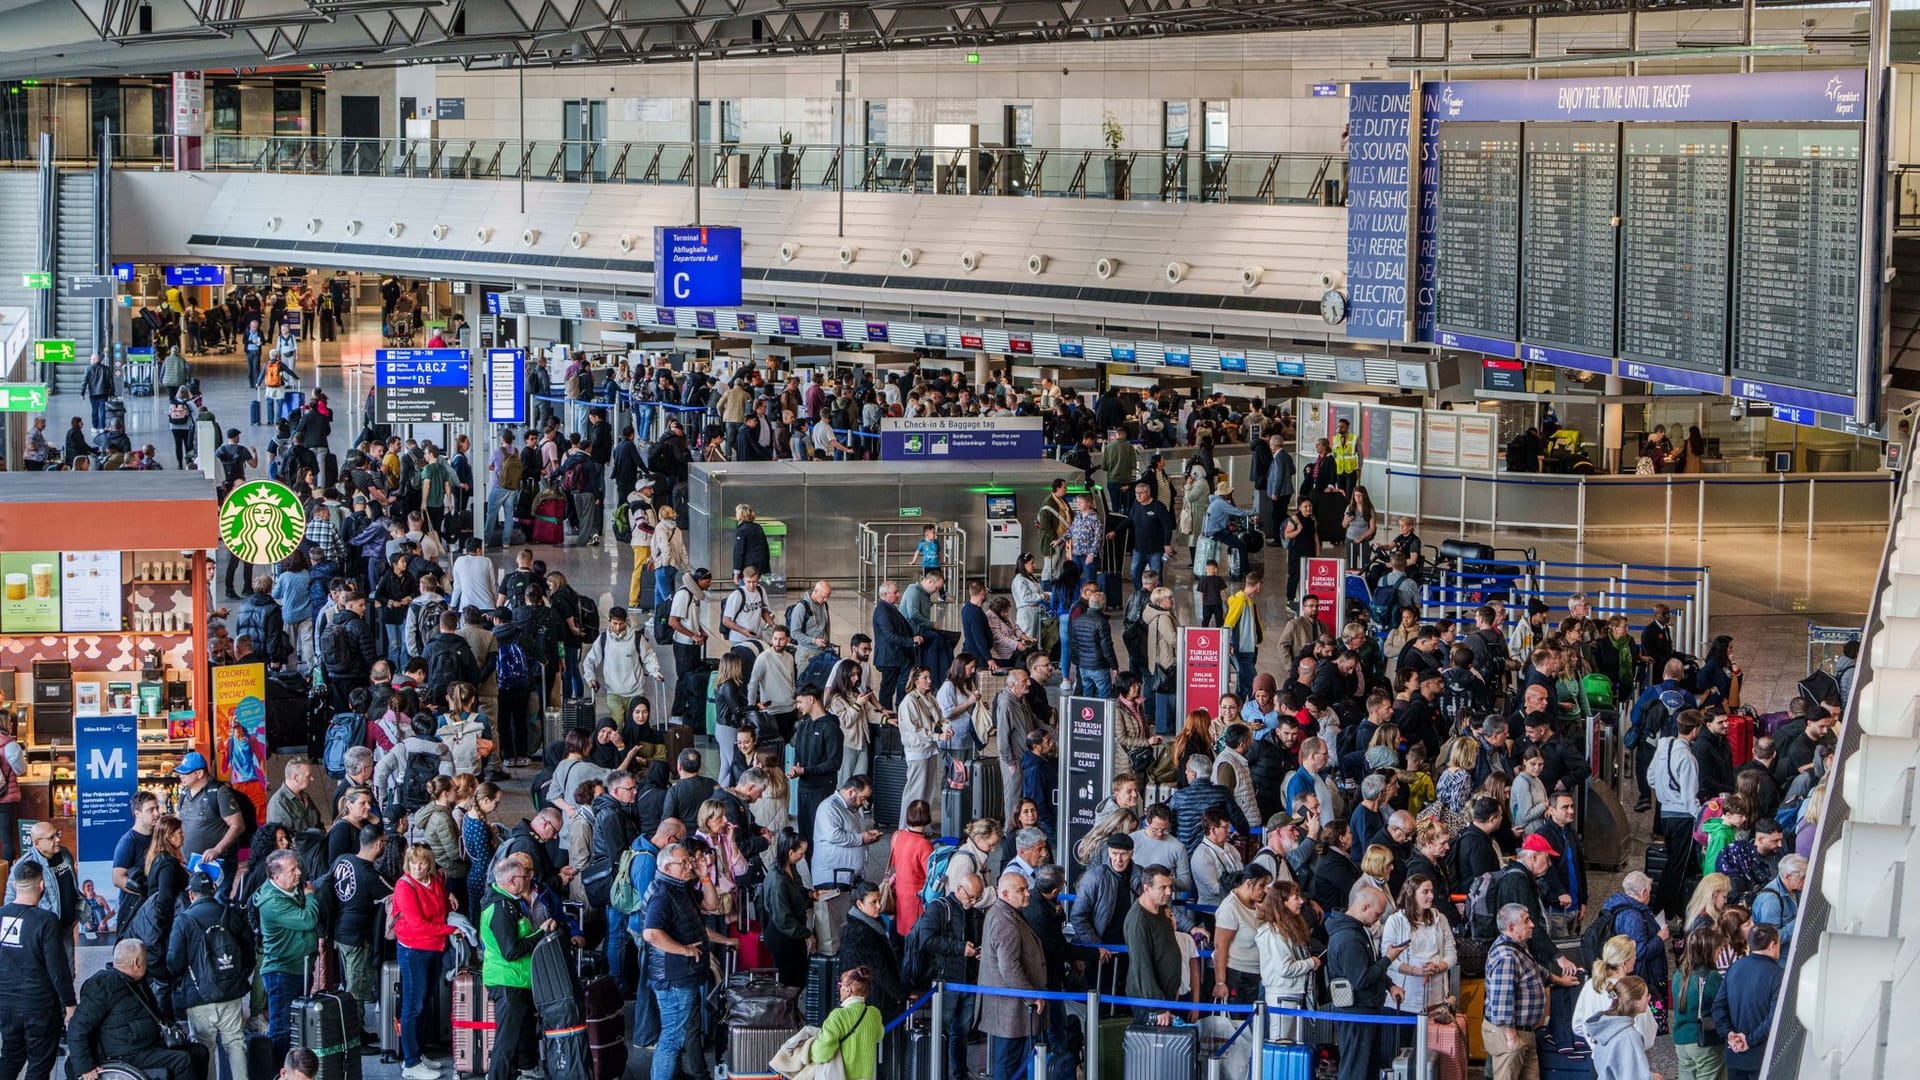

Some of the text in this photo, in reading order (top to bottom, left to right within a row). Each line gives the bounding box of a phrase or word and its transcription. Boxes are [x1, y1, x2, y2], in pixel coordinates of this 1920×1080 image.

[1558, 84, 1692, 114] ENJOY THE TIME UNTIL TAKEOFF
[1837, 91, 1860, 102] Frankfurt
[1350, 95, 1379, 112] DINE
[1381, 94, 1410, 113] DINE
[1836, 103, 1854, 116] Airport
[1364, 118, 1399, 137] DUTY
[1377, 166, 1408, 185] MILE
[673, 246, 708, 254] Abflughalle
[673, 254, 706, 263] Departures
[1347, 260, 1374, 279] EALS
[1375, 261, 1405, 280] DEAL
[674, 272, 690, 299] C
[1376, 308, 1406, 328] GIFT
[894, 420, 900, 428] 1.
[904, 420, 937, 428] Check-in
[948, 420, 980, 430] Baggage
[982, 420, 995, 430] tag
[218, 669, 250, 678] COLORFUL
[218, 678, 257, 688] SPRINGTIME
[218, 689, 247, 699] SPECIALS
[1074, 721, 1102, 730] TURKISH
[1073, 728, 1102, 736] AIRLINES
[1074, 752, 1100, 760] BUSINESS
[86, 748, 127, 780] M
